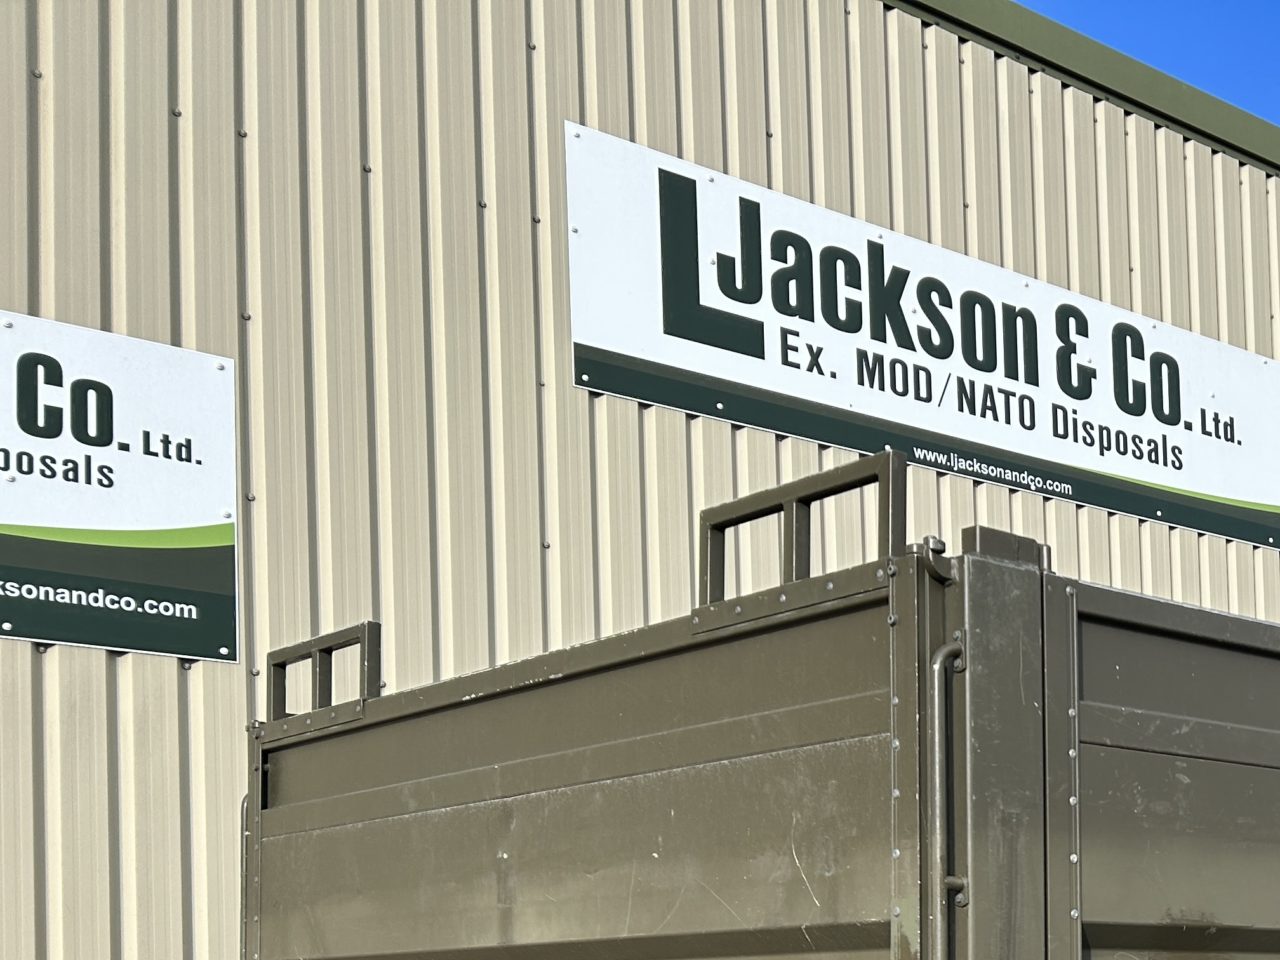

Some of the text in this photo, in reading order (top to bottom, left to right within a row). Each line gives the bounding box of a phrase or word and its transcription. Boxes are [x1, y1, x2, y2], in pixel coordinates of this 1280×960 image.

[16, 351, 203, 466] Co. Ltd.
[780, 326, 1184, 471] Ex. MOD/NATO Disposals
[1054, 303, 1097, 401] &
[1111, 321, 1193, 432] Co.
[1200, 406, 1243, 446] Ltd.
[912, 446, 1073, 496] www.ljacksonandco.com
